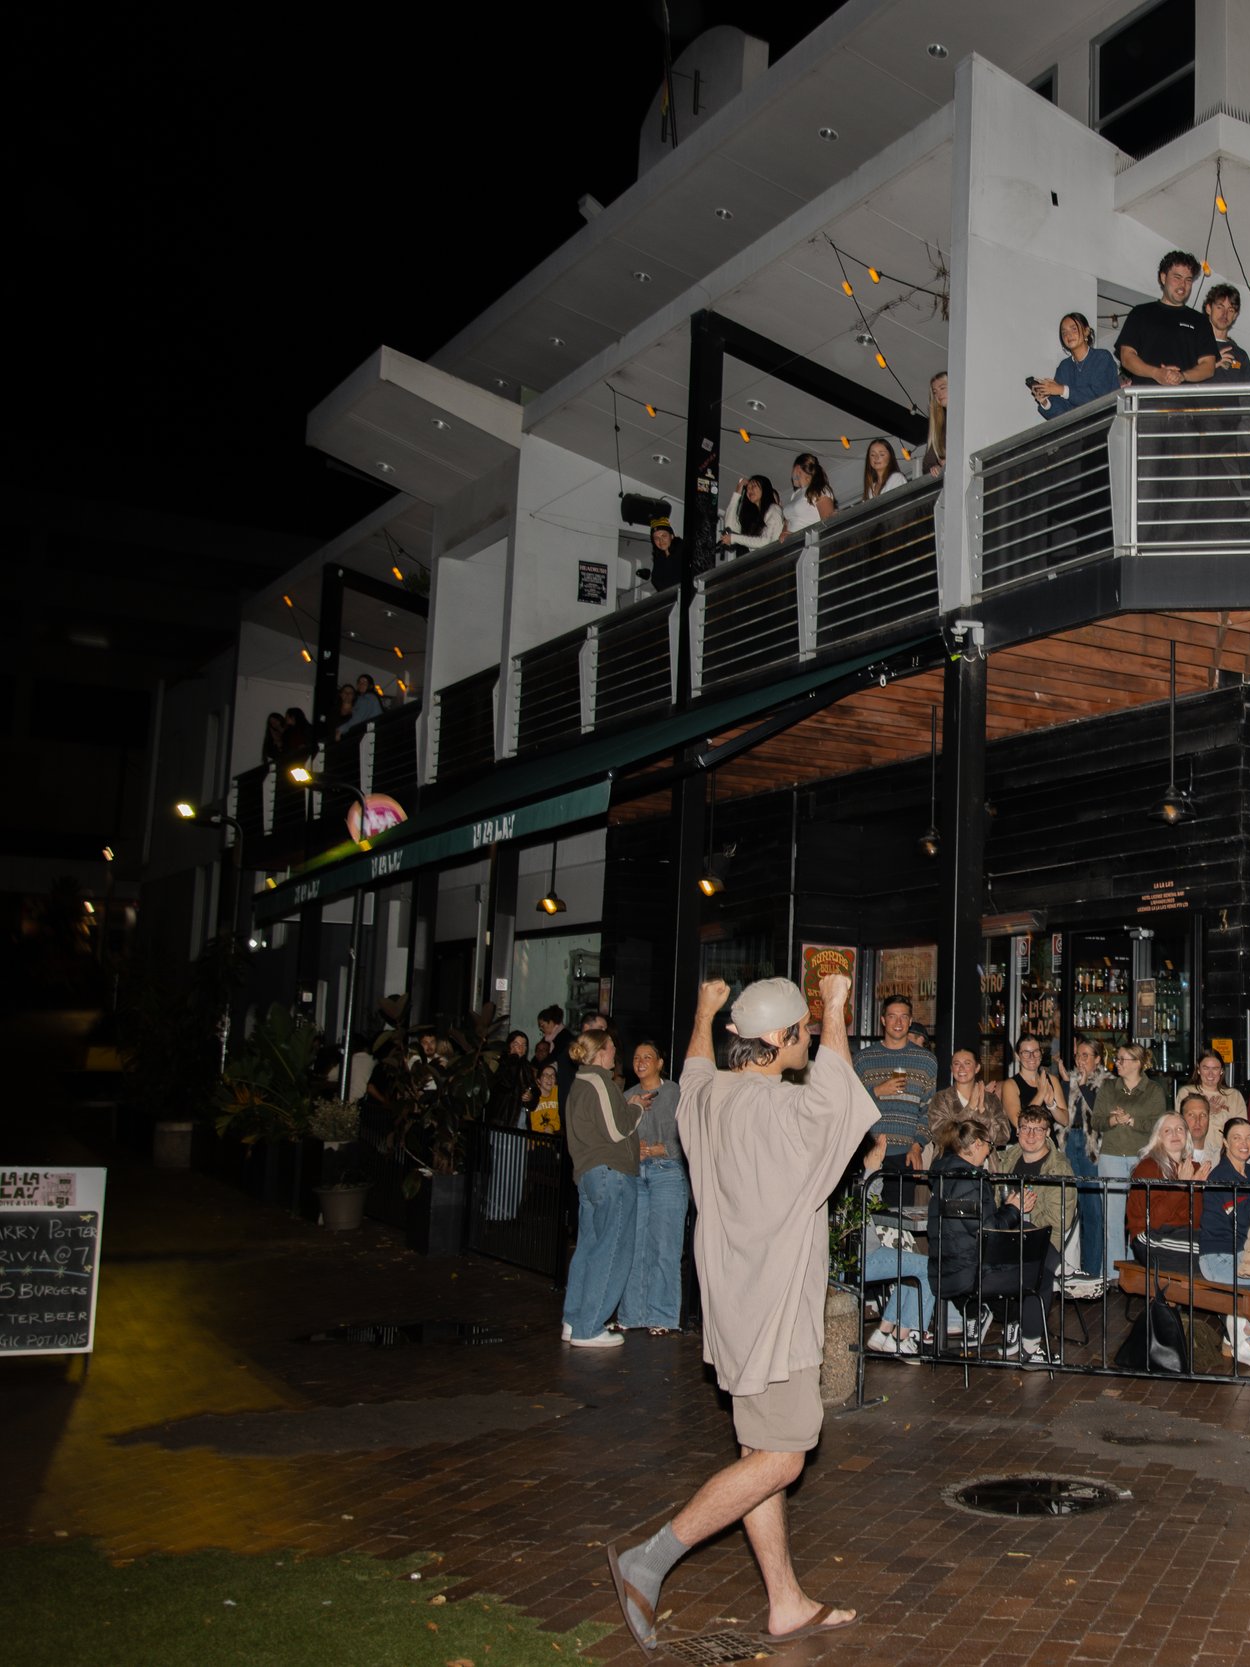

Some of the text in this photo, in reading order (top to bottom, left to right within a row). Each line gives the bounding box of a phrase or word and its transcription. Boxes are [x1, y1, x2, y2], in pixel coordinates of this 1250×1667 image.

[49, 1219, 98, 1240] POTTER
[18, 1283, 88, 1299] BURGERS
[27, 1332, 88, 1347] POTIONS
